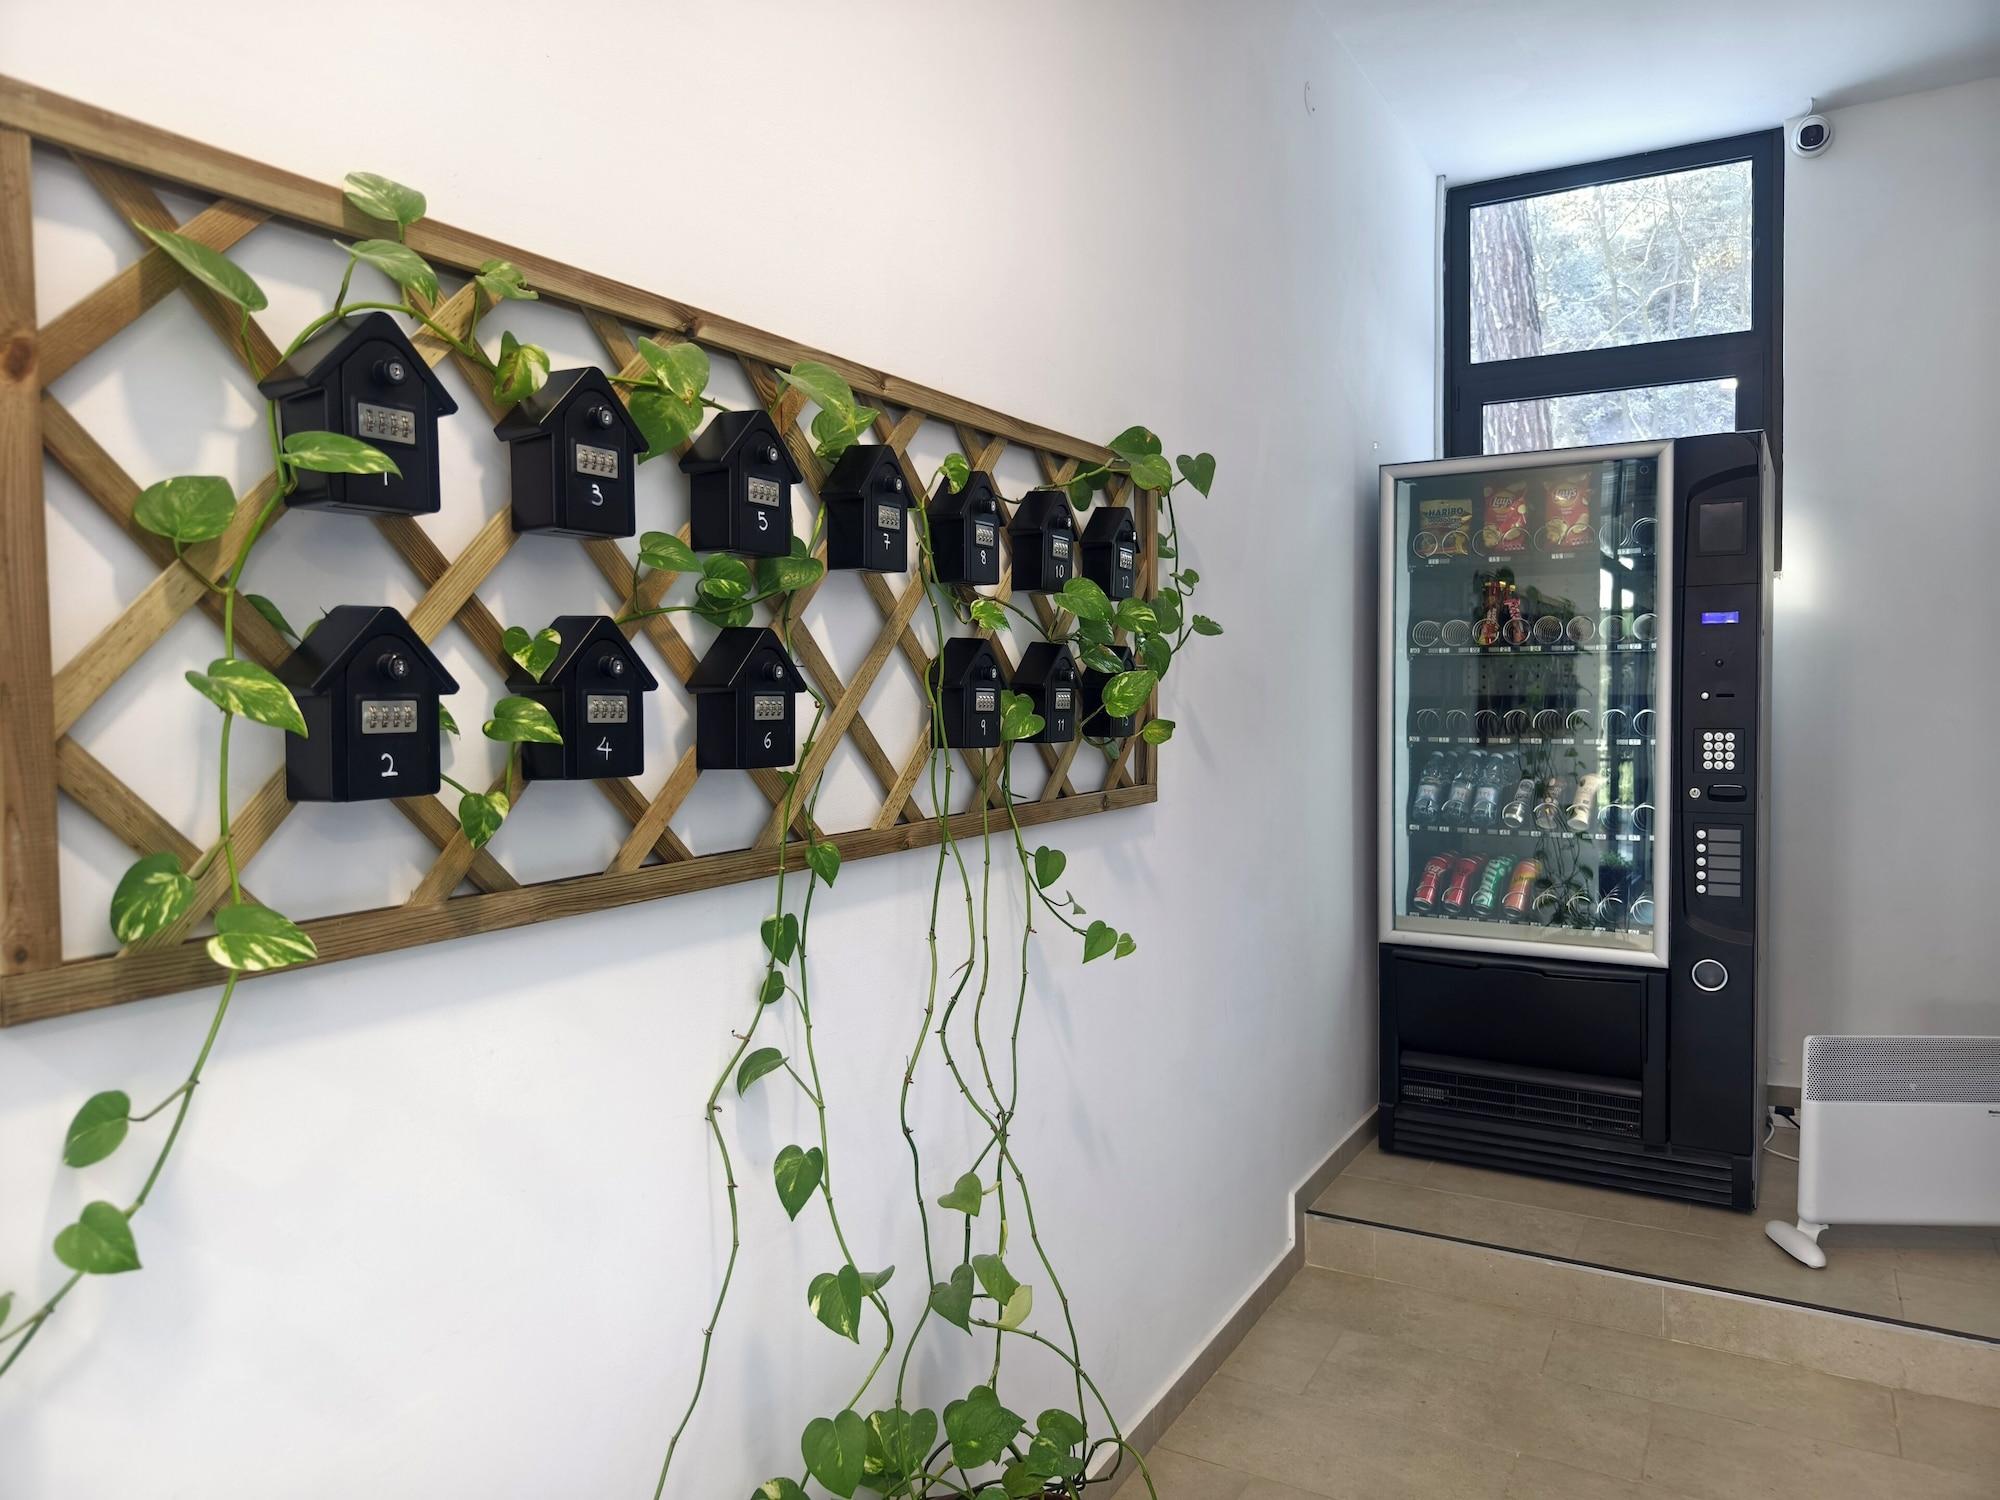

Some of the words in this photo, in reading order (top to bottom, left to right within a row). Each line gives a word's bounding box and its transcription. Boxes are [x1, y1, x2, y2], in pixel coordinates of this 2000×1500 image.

[591, 483, 604, 507] 3
[757, 510, 769, 531] 5
[1428, 507, 1464, 517] HARIBO
[883, 532, 891, 551] 7
[980, 549, 987, 566] 8
[1055, 564, 1065, 579] 10
[1121, 575, 1130, 589] 12
[980, 719, 986, 736] 9
[1057, 718, 1065, 732] 11
[596, 736, 613, 761] 4
[763, 731, 772, 749] 6
[380, 752, 399, 778] 2
